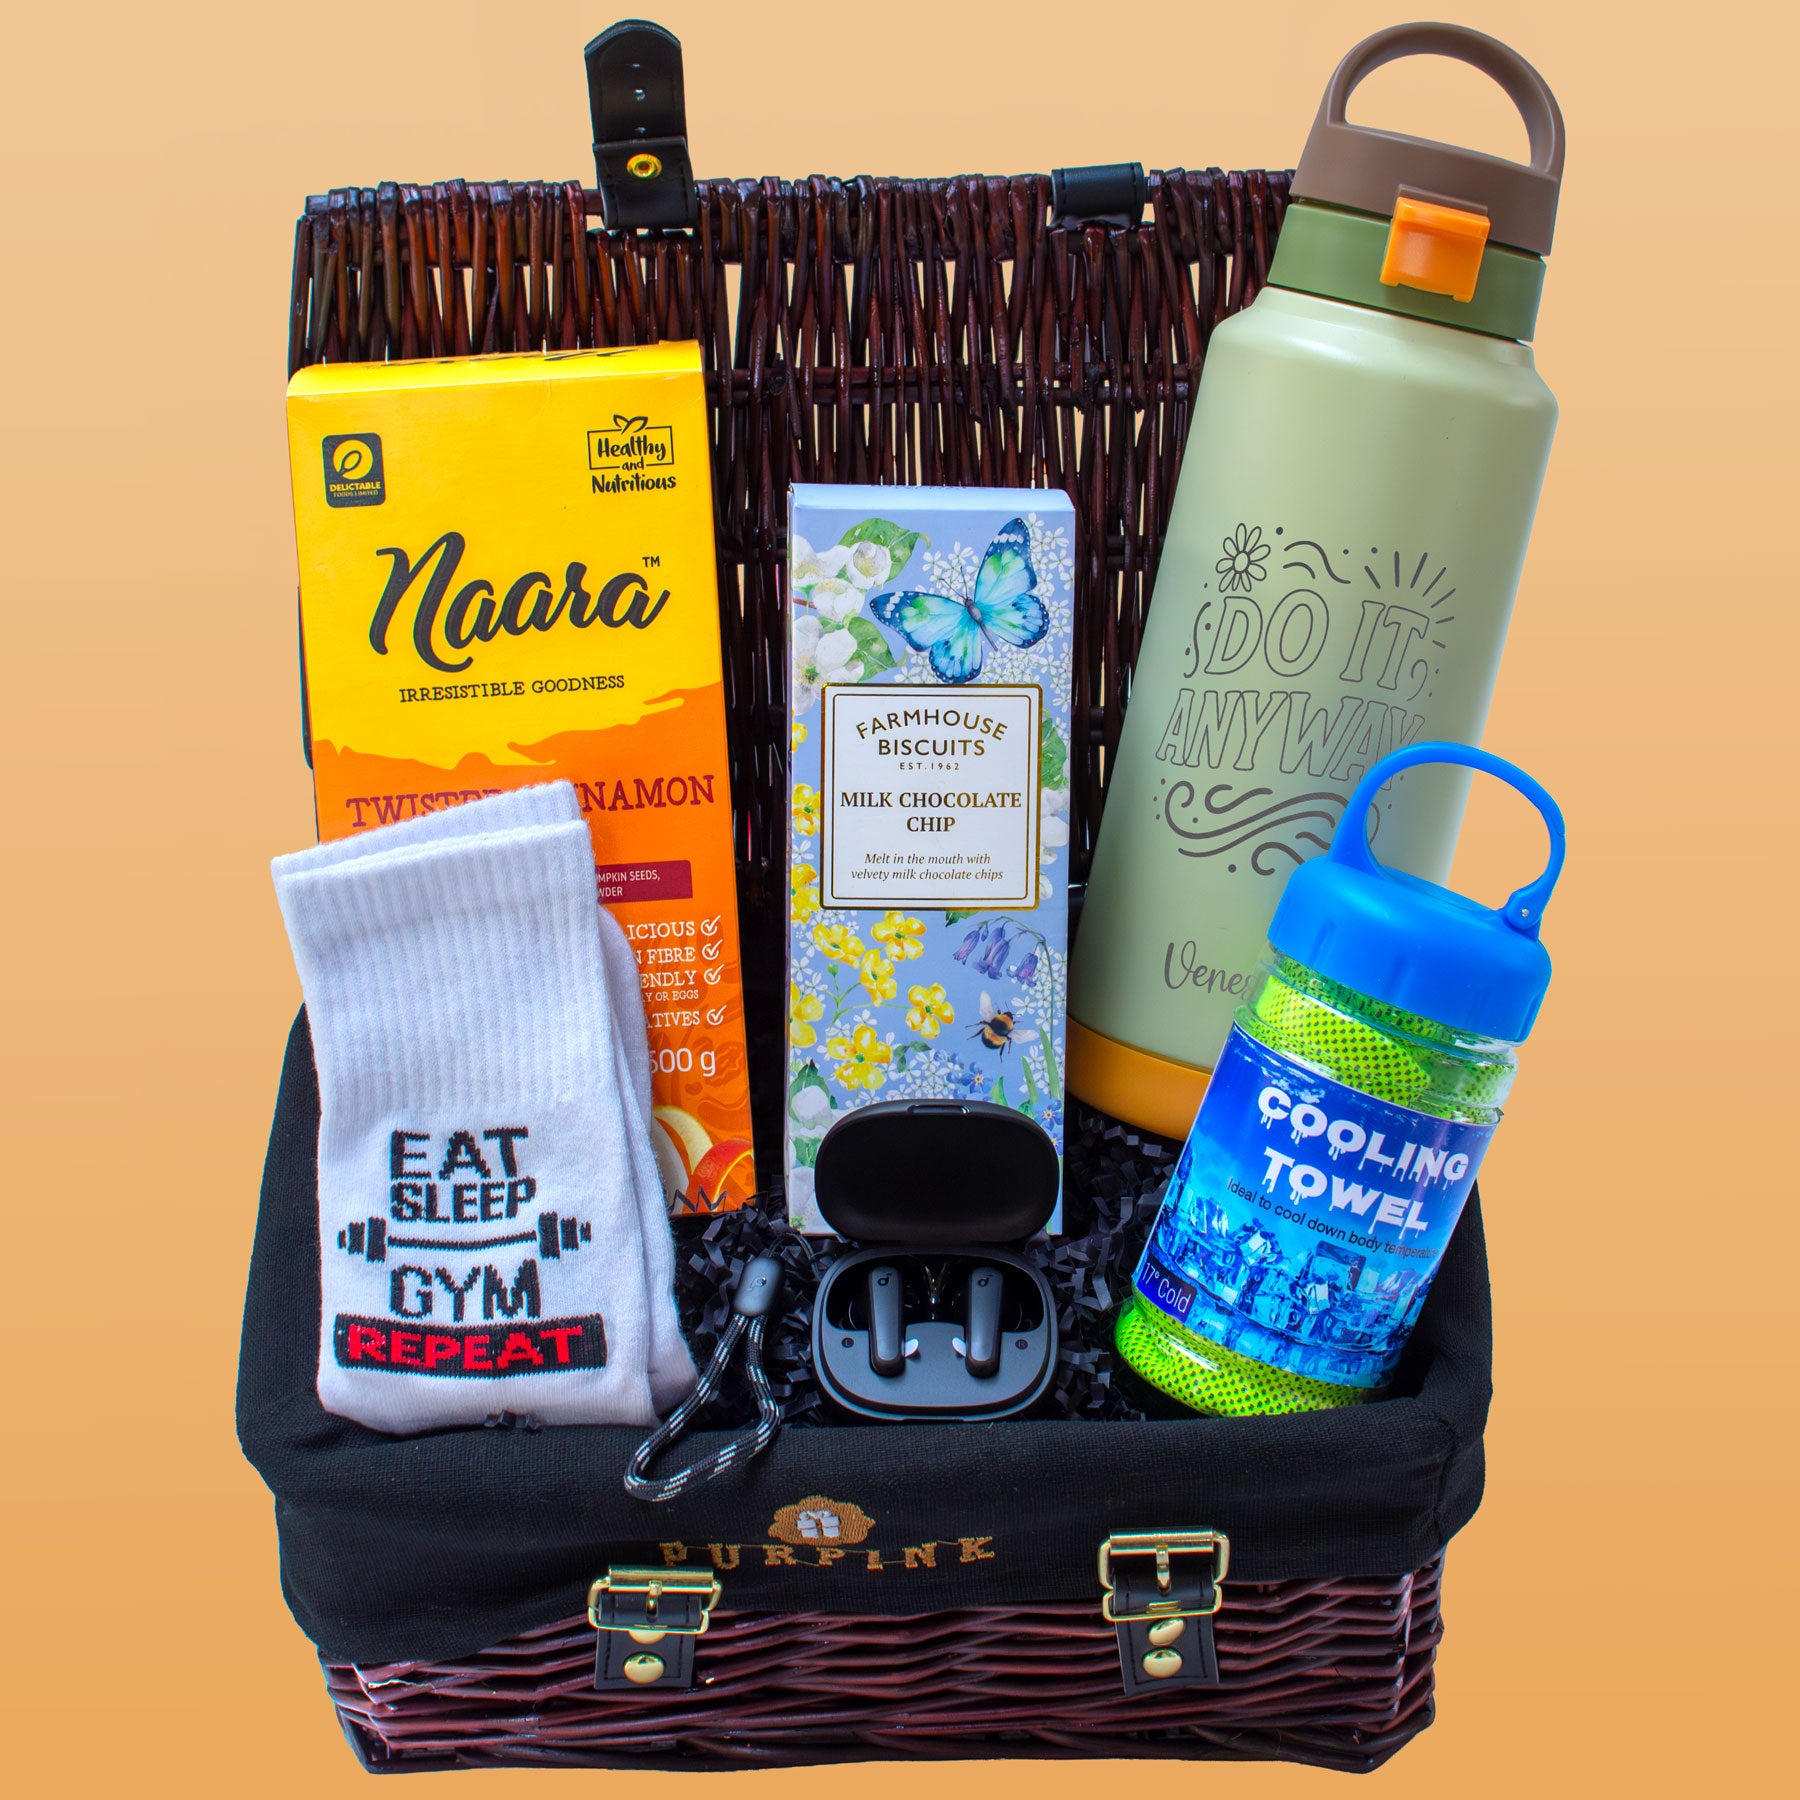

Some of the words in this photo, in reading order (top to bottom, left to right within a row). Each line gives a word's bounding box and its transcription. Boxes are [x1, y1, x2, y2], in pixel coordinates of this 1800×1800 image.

[598, 435, 666, 461] Healthy
[622, 456, 644, 471] and
[329, 482, 381, 492] DELICTABLE
[592, 473, 676, 493] Nutritious
[369, 531, 670, 672] Naara
[1204, 589, 1329, 676] DO
[399, 681, 525, 702] IRRESISTIBLE
[532, 675, 625, 694] GOODNESS
[856, 709, 1008, 740] FARMHOUSE
[878, 739, 985, 756] BISCUITS
[1155, 688, 1425, 790] ANYWAY
[840, 792, 893, 808] MILK
[899, 792, 1022, 808] CHOCOLATE
[906, 817, 956, 832] CHIP
[865, 853, 890, 864] Melt
[893, 853, 904, 864] in
[907, 853, 925, 864] the
[928, 854, 964, 864] mouth
[967, 853, 991, 864] with
[597, 871, 627, 883] MPKIN
[630, 869, 660, 881] SEEDS,
[851, 869, 890, 881] velvety
[892, 869, 917, 880] milk
[919, 869, 972, 880] chocolate
[974, 869, 1004, 881] chips
[625, 921, 695, 940] ICIOUS
[647, 946, 696, 964] FIBRE
[655, 991, 669, 1001] OR
[672, 989, 699, 1000] EGGS
[700, 1050, 716, 1077] g
[1258, 1086, 1469, 1190] COOLING
[389, 1126, 529, 1181] EAT
[389, 1176, 537, 1223] SLEEP
[1261, 1146, 1429, 1240] TOWEL
[1227, 1177, 1257, 1203] Ideal
[1258, 1195, 1272, 1211] to
[1274, 1205, 1307, 1225] cool
[1307, 1218, 1346, 1241] down
[1347, 1230, 1383, 1254] body
[390, 1258, 541, 1322] GYM
[1158, 1277, 1192, 1313] Cold
[349, 1324, 583, 1370] REPEAT
[659, 1536, 995, 1571] PURPINK
